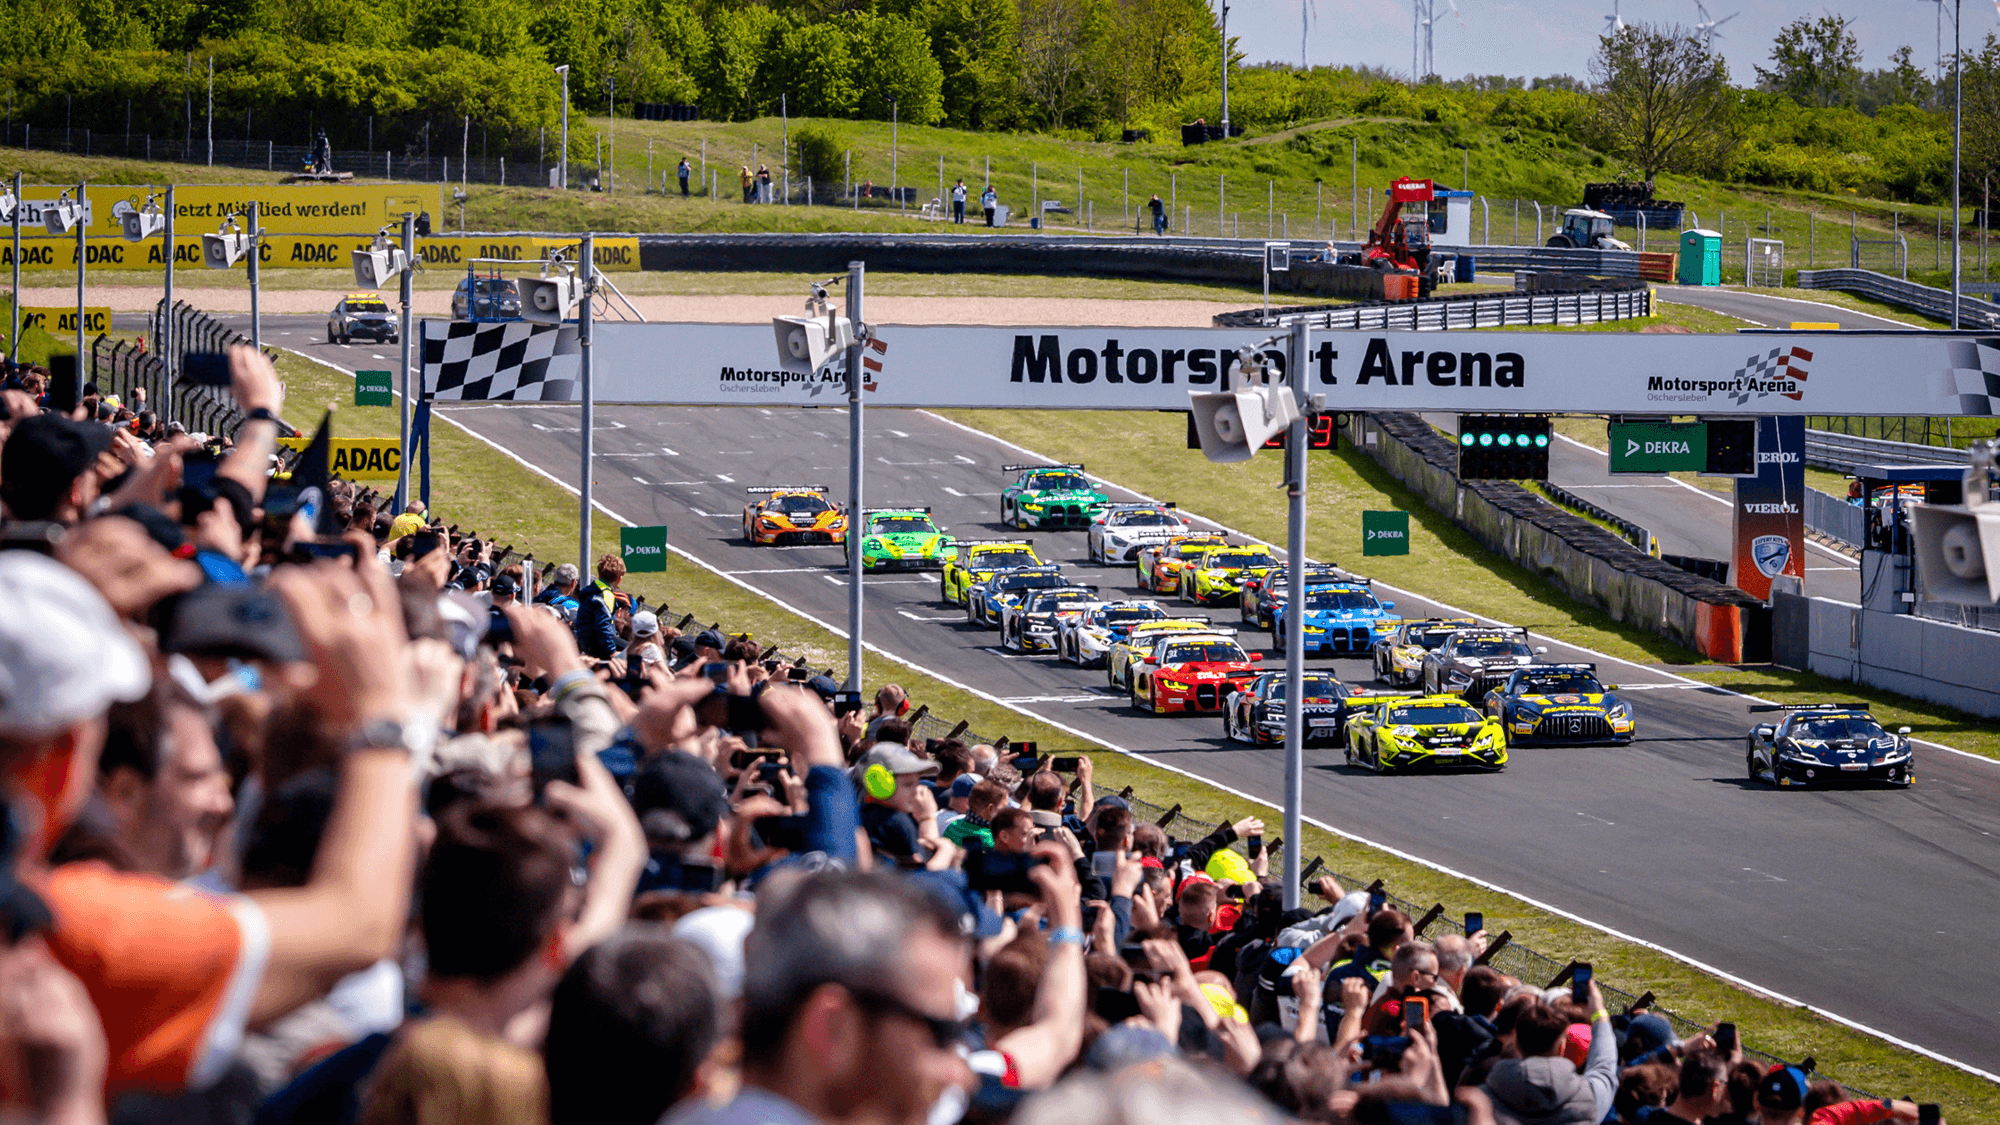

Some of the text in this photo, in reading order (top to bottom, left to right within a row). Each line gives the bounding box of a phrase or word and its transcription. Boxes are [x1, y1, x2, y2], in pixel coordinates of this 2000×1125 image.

[217, 201, 292, 217] Mitlied
[296, 201, 366, 217] werden!
[290, 242, 338, 262] ADAC
[419, 244, 461, 263] ADAC
[480, 245, 522, 260] ADAC
[1356, 338, 1525, 388] Arena
[366, 385, 389, 393] DEKRA
[720, 383, 780, 392] Oschersleben
[1647, 376, 1796, 396] Motorsport Arena
[1646, 393, 1707, 402] Oschersleben
[1645, 441, 1690, 454] DEKRA
[331, 447, 401, 471] ADAC
[1744, 503, 1799, 513] VIEROL
[1378, 530, 1404, 538] DEKRA
[1393, 709, 1408, 717] 92
[1307, 727, 1337, 740] ABT
